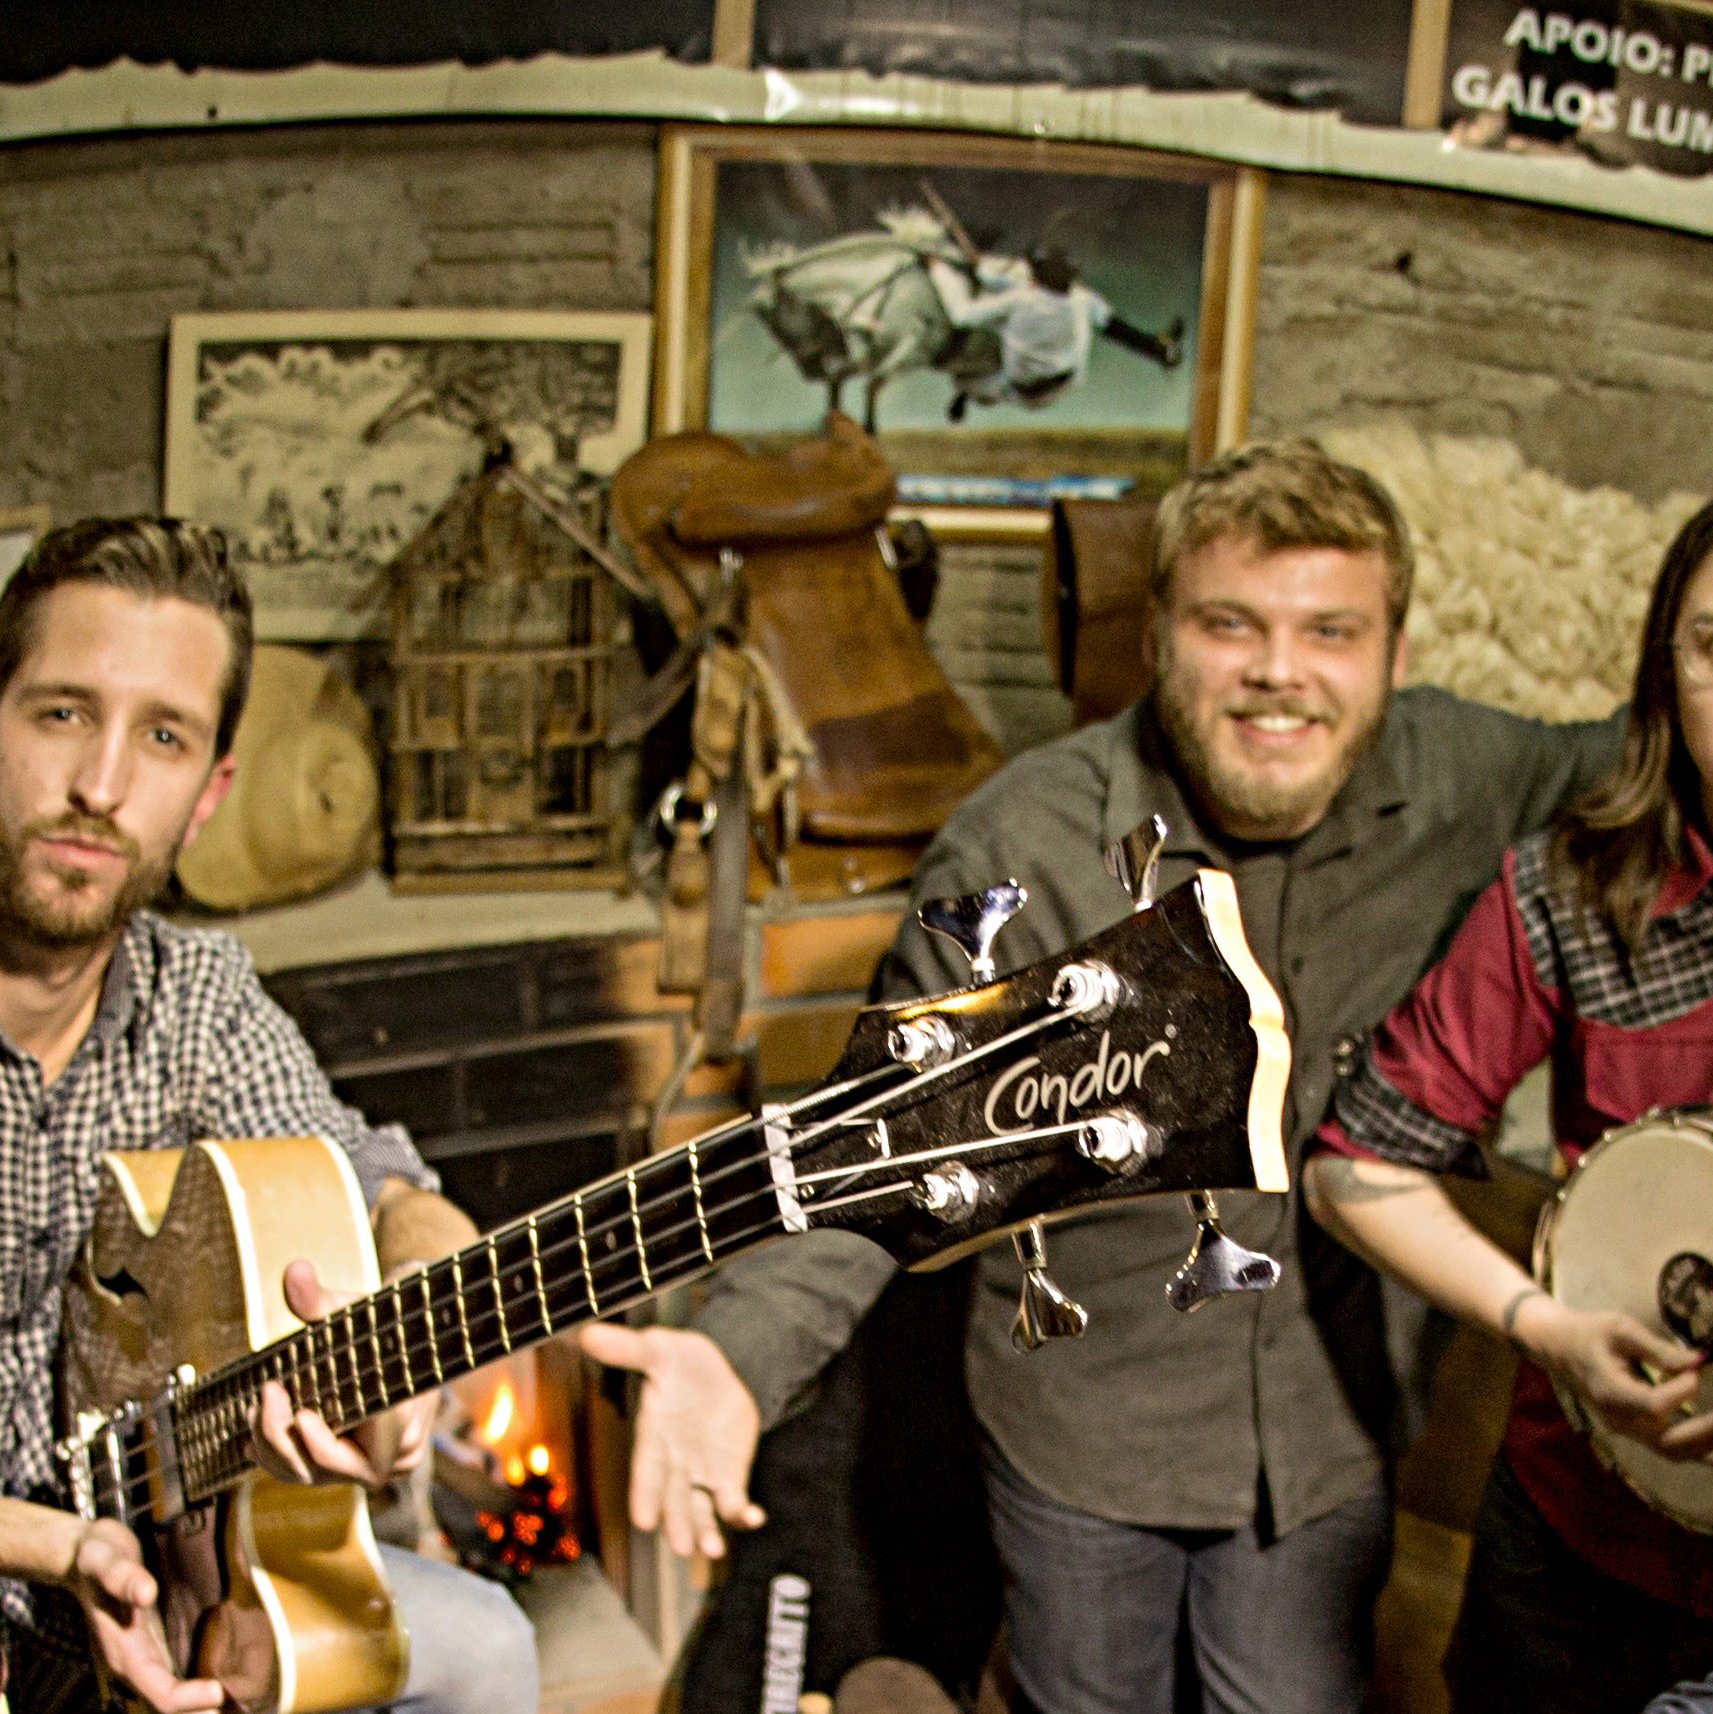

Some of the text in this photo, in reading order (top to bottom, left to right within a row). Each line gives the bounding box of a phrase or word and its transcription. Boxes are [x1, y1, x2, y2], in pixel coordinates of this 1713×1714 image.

[1504, 8, 1674, 78] APOIO:
[1450, 64, 1619, 130] GALOS
[985, 1031, 1169, 1135] Condor
